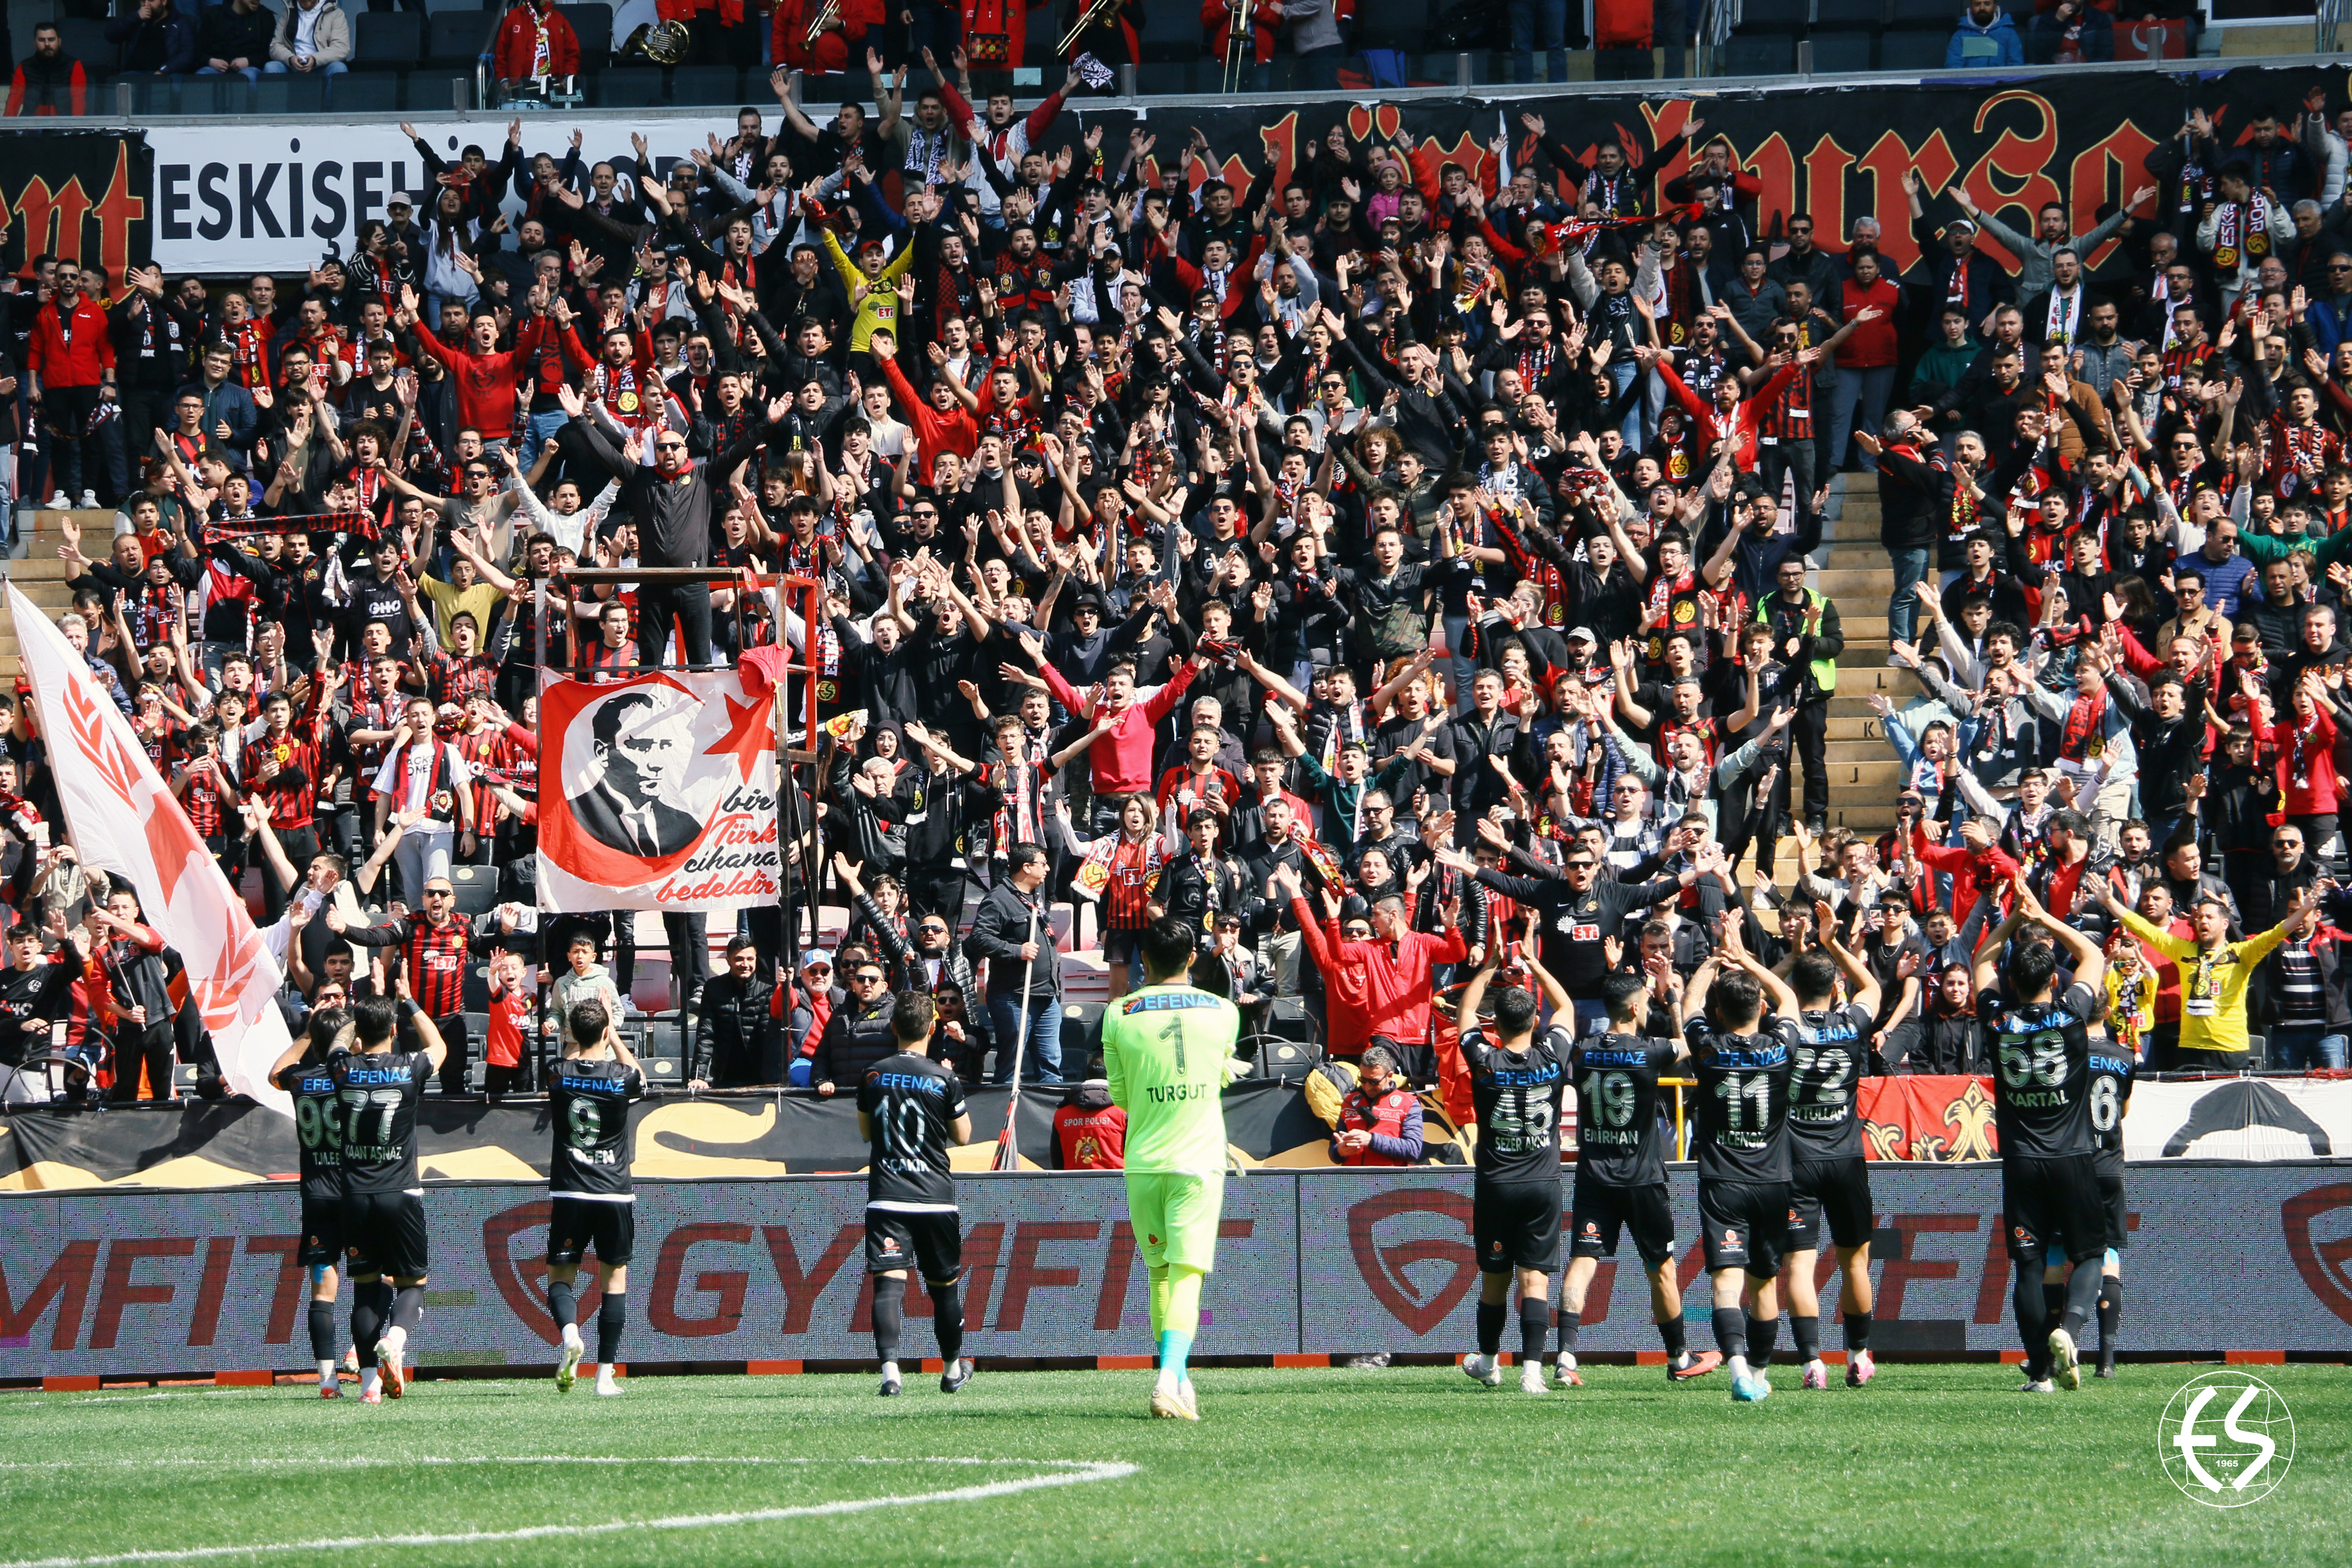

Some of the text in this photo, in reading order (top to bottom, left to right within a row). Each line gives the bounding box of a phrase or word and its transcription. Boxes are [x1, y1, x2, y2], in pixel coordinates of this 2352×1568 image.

[879, 307, 894, 318] ETi
[1877, 673, 1886, 689] L
[1864, 721, 1874, 737] K
[1849, 767, 1858, 782] J
[200, 792, 216, 802] ETi
[723, 786, 775, 812] bir
[708, 814, 777, 844] Türk
[684, 843, 777, 874] cihana
[658, 868, 777, 903] bedeldir
[1572, 924, 1599, 941] ETi
[434, 956, 457, 970] ETi
[1143, 992, 1221, 1011] EFENAZ
[1158, 1011, 1187, 1077] 1
[1584, 1051, 1646, 1065] EFENAZ
[1718, 1046, 1788, 1068] EFENAZ
[2000, 1030, 2068, 1087] 58
[349, 1067, 413, 1084] EFENAZ
[881, 1072, 945, 1093] EFENAZ
[1495, 1063, 1559, 1085] EFENAZ
[1788, 1049, 1852, 1103] 72
[562, 1077, 625, 1093] EFENAZ
[1147, 1083, 1207, 1103] TURGUT
[1580, 1070, 1635, 1127] 19
[1715, 1071, 1770, 1130] 11
[2007, 1090, 2070, 1107] KARTAL
[2090, 1075, 2118, 1131] 6
[341, 1090, 403, 1145] 77
[1490, 1085, 1554, 1138] 45
[1788, 1105, 1847, 1122] EYTULLAH
[568, 1097, 600, 1149] 9
[874, 1095, 925, 1155] 10
[1064, 1118, 1084, 1127] SPOR
[1494, 1136, 1522, 1152] SEZER
[345, 1145, 403, 1164] KAAN AŞNAZ
